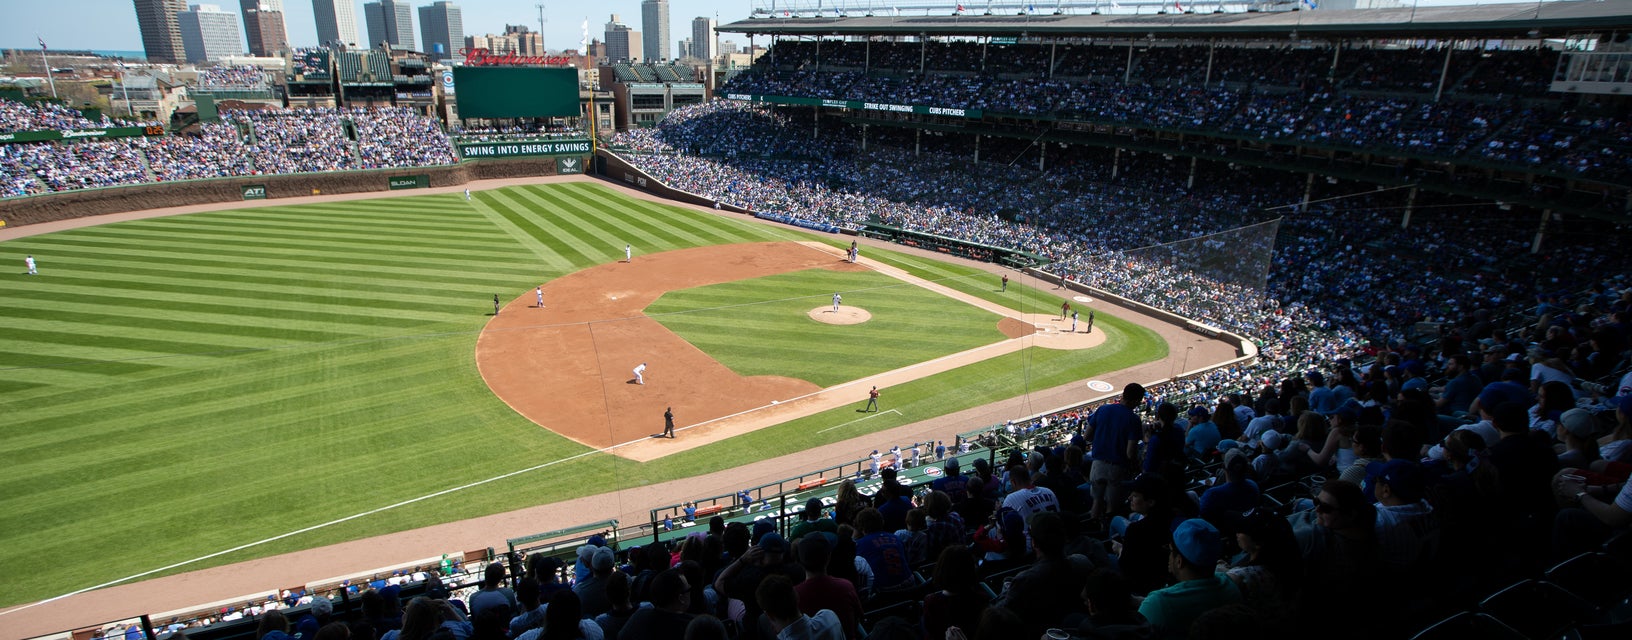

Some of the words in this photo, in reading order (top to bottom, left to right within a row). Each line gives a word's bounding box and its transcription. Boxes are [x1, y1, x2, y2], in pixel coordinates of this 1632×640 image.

[459, 48, 570, 66] Budweiser
[864, 102, 879, 110] STRIKE
[879, 103, 889, 111] OUT
[889, 104, 913, 112] SWINGING
[929, 107, 941, 115] CUBS
[942, 108, 965, 116] PITCHERS
[60, 130, 106, 138] Budweiser
[465, 146, 495, 156] SWING
[497, 145, 518, 154] INTO
[521, 144, 552, 154] ENERGY
[555, 142, 589, 152] SAVINGS
[244, 187, 264, 195] ATI
[1025, 493, 1053, 508] BRYANT
